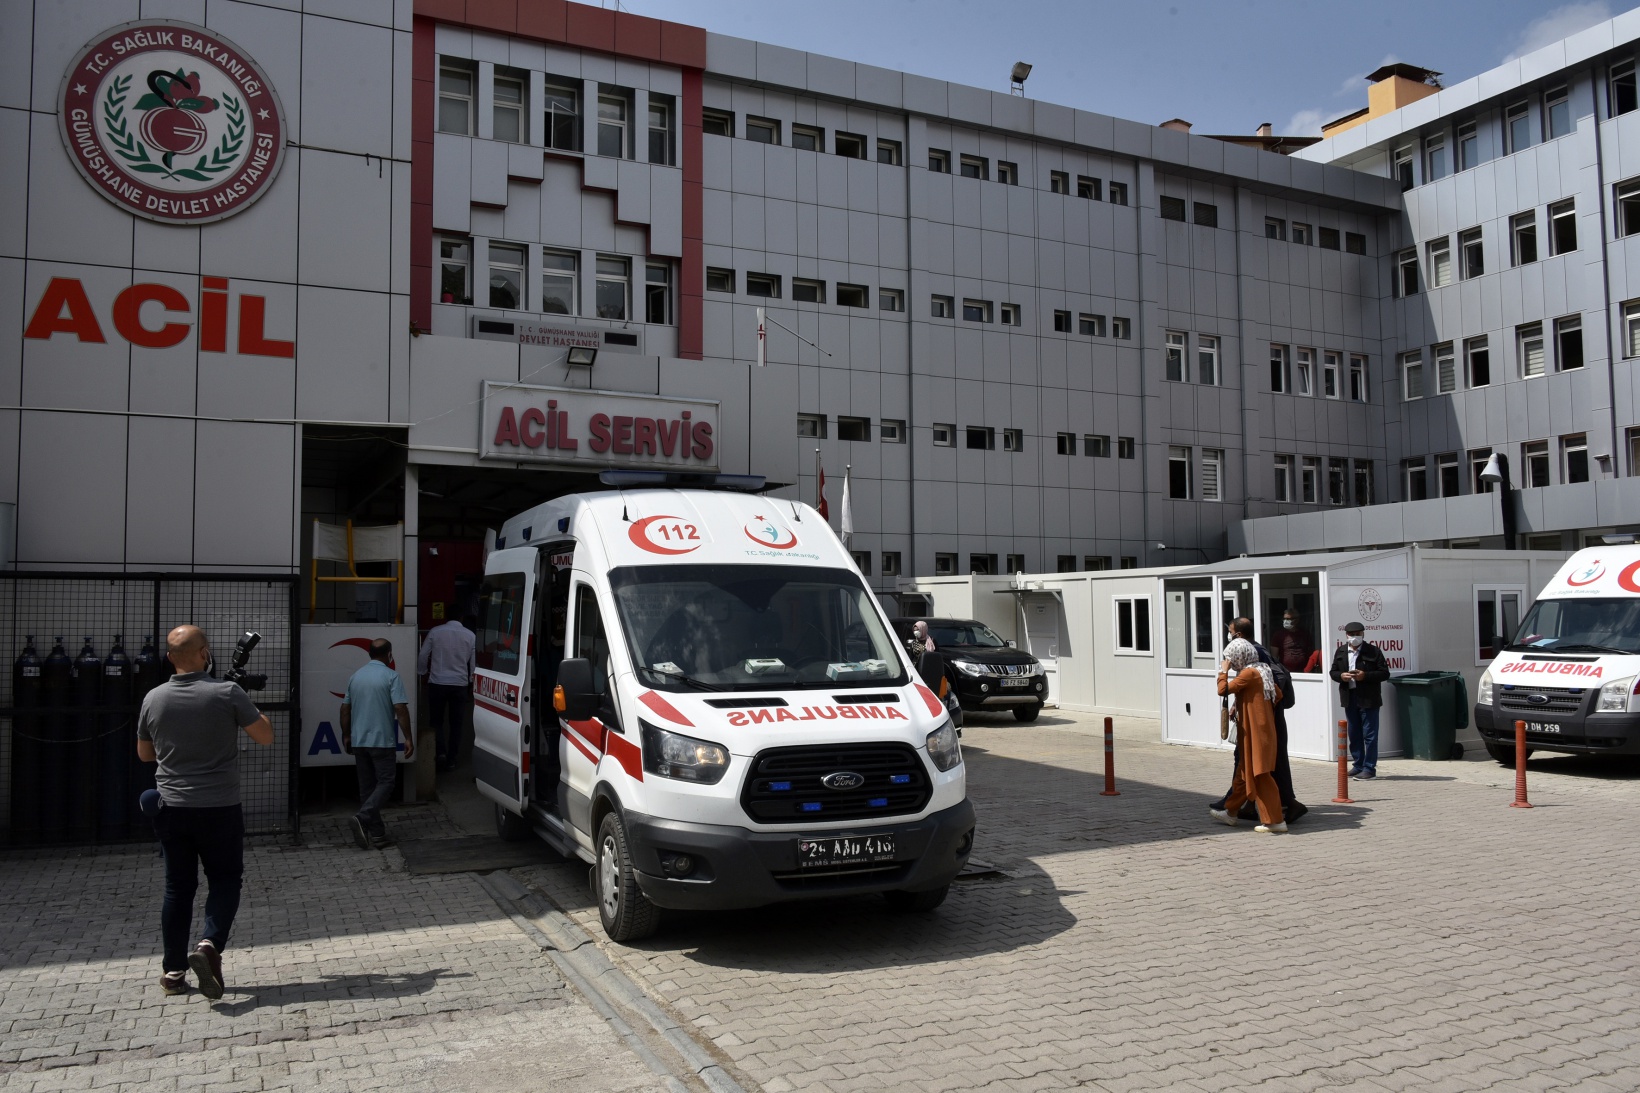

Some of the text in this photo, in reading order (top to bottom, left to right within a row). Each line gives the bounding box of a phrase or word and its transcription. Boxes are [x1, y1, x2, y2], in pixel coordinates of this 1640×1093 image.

[85, 30, 262, 98] T.C. SAĞLIK BAKANLIĞI
[71, 108, 274, 215] GÜMÜŞHANE DEVLET HASTANESİ
[22, 276, 295, 359] ACİL
[519, 334, 551, 345] DEVLET
[494, 400, 714, 460] ACİL SERVİS
[658, 524, 700, 541] 112
[1544, 723, 1560, 733] 259
[833, 775, 856, 786] Ford
